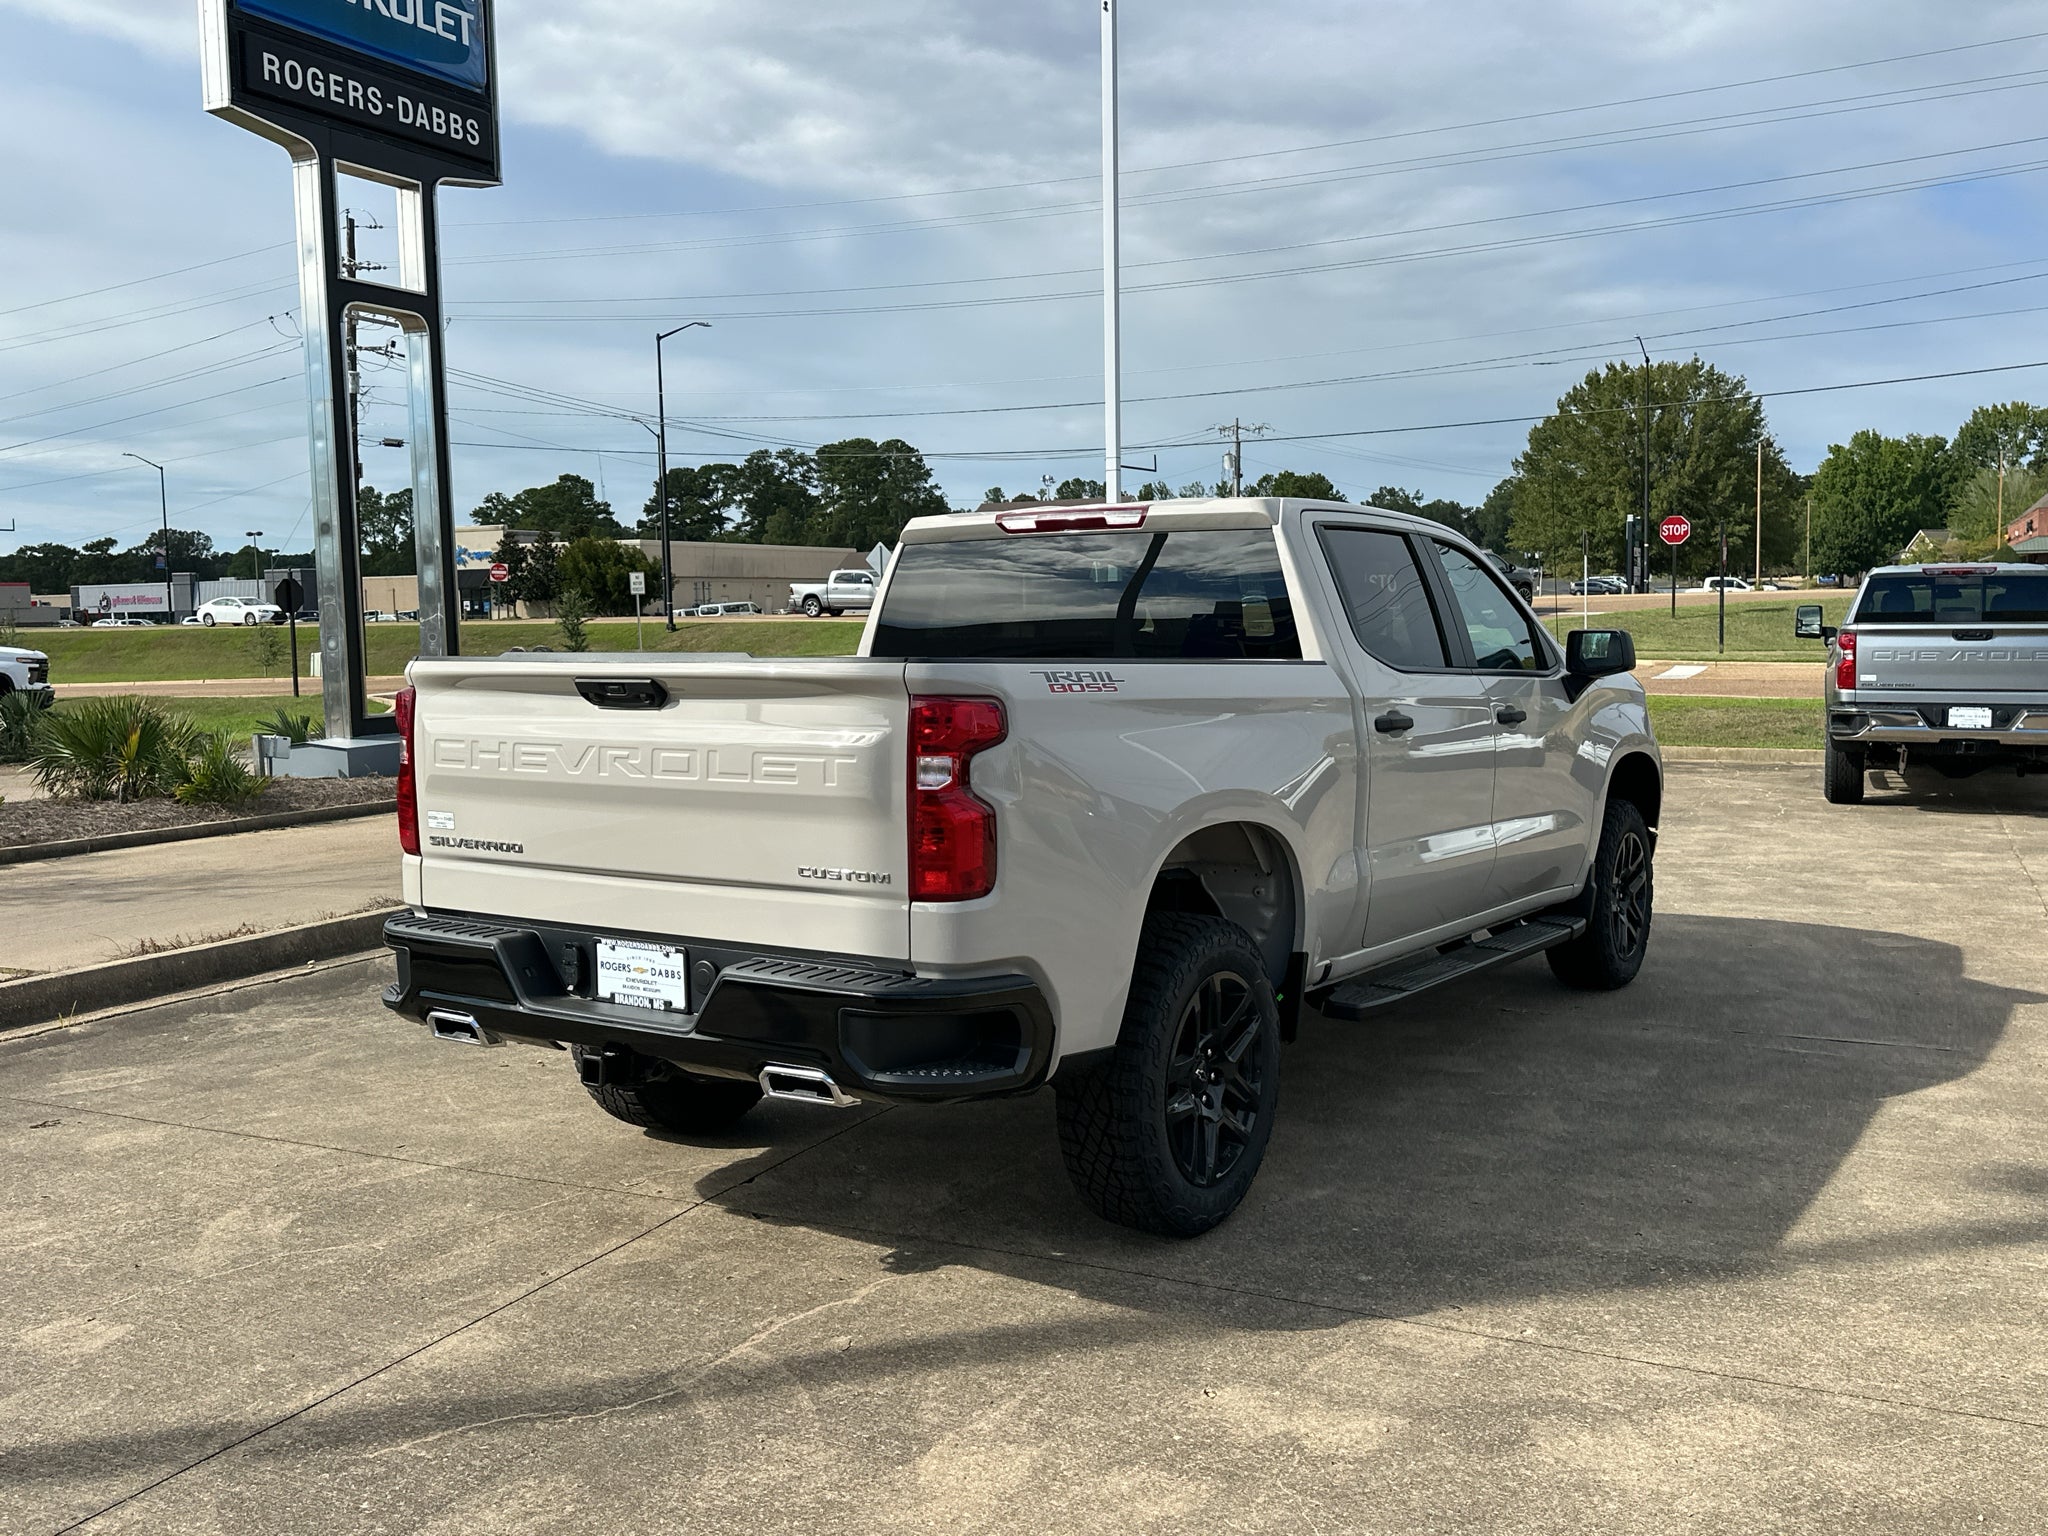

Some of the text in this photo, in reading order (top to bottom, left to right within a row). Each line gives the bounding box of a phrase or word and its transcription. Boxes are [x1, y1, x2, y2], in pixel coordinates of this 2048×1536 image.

[262, 52, 480, 146] ROGERS-DABBS
[1662, 524, 1688, 536] STOP
[1030, 671, 1125, 682] TRAIL
[1048, 683, 1118, 693] BOSS
[433, 739, 857, 786] CHEVROLET
[429, 836, 523, 853] SILVERADO
[798, 867, 891, 884] CUSTOM
[600, 961, 682, 980] ROGERS DABBS
[615, 992, 665, 1010] BRANDON, MS
